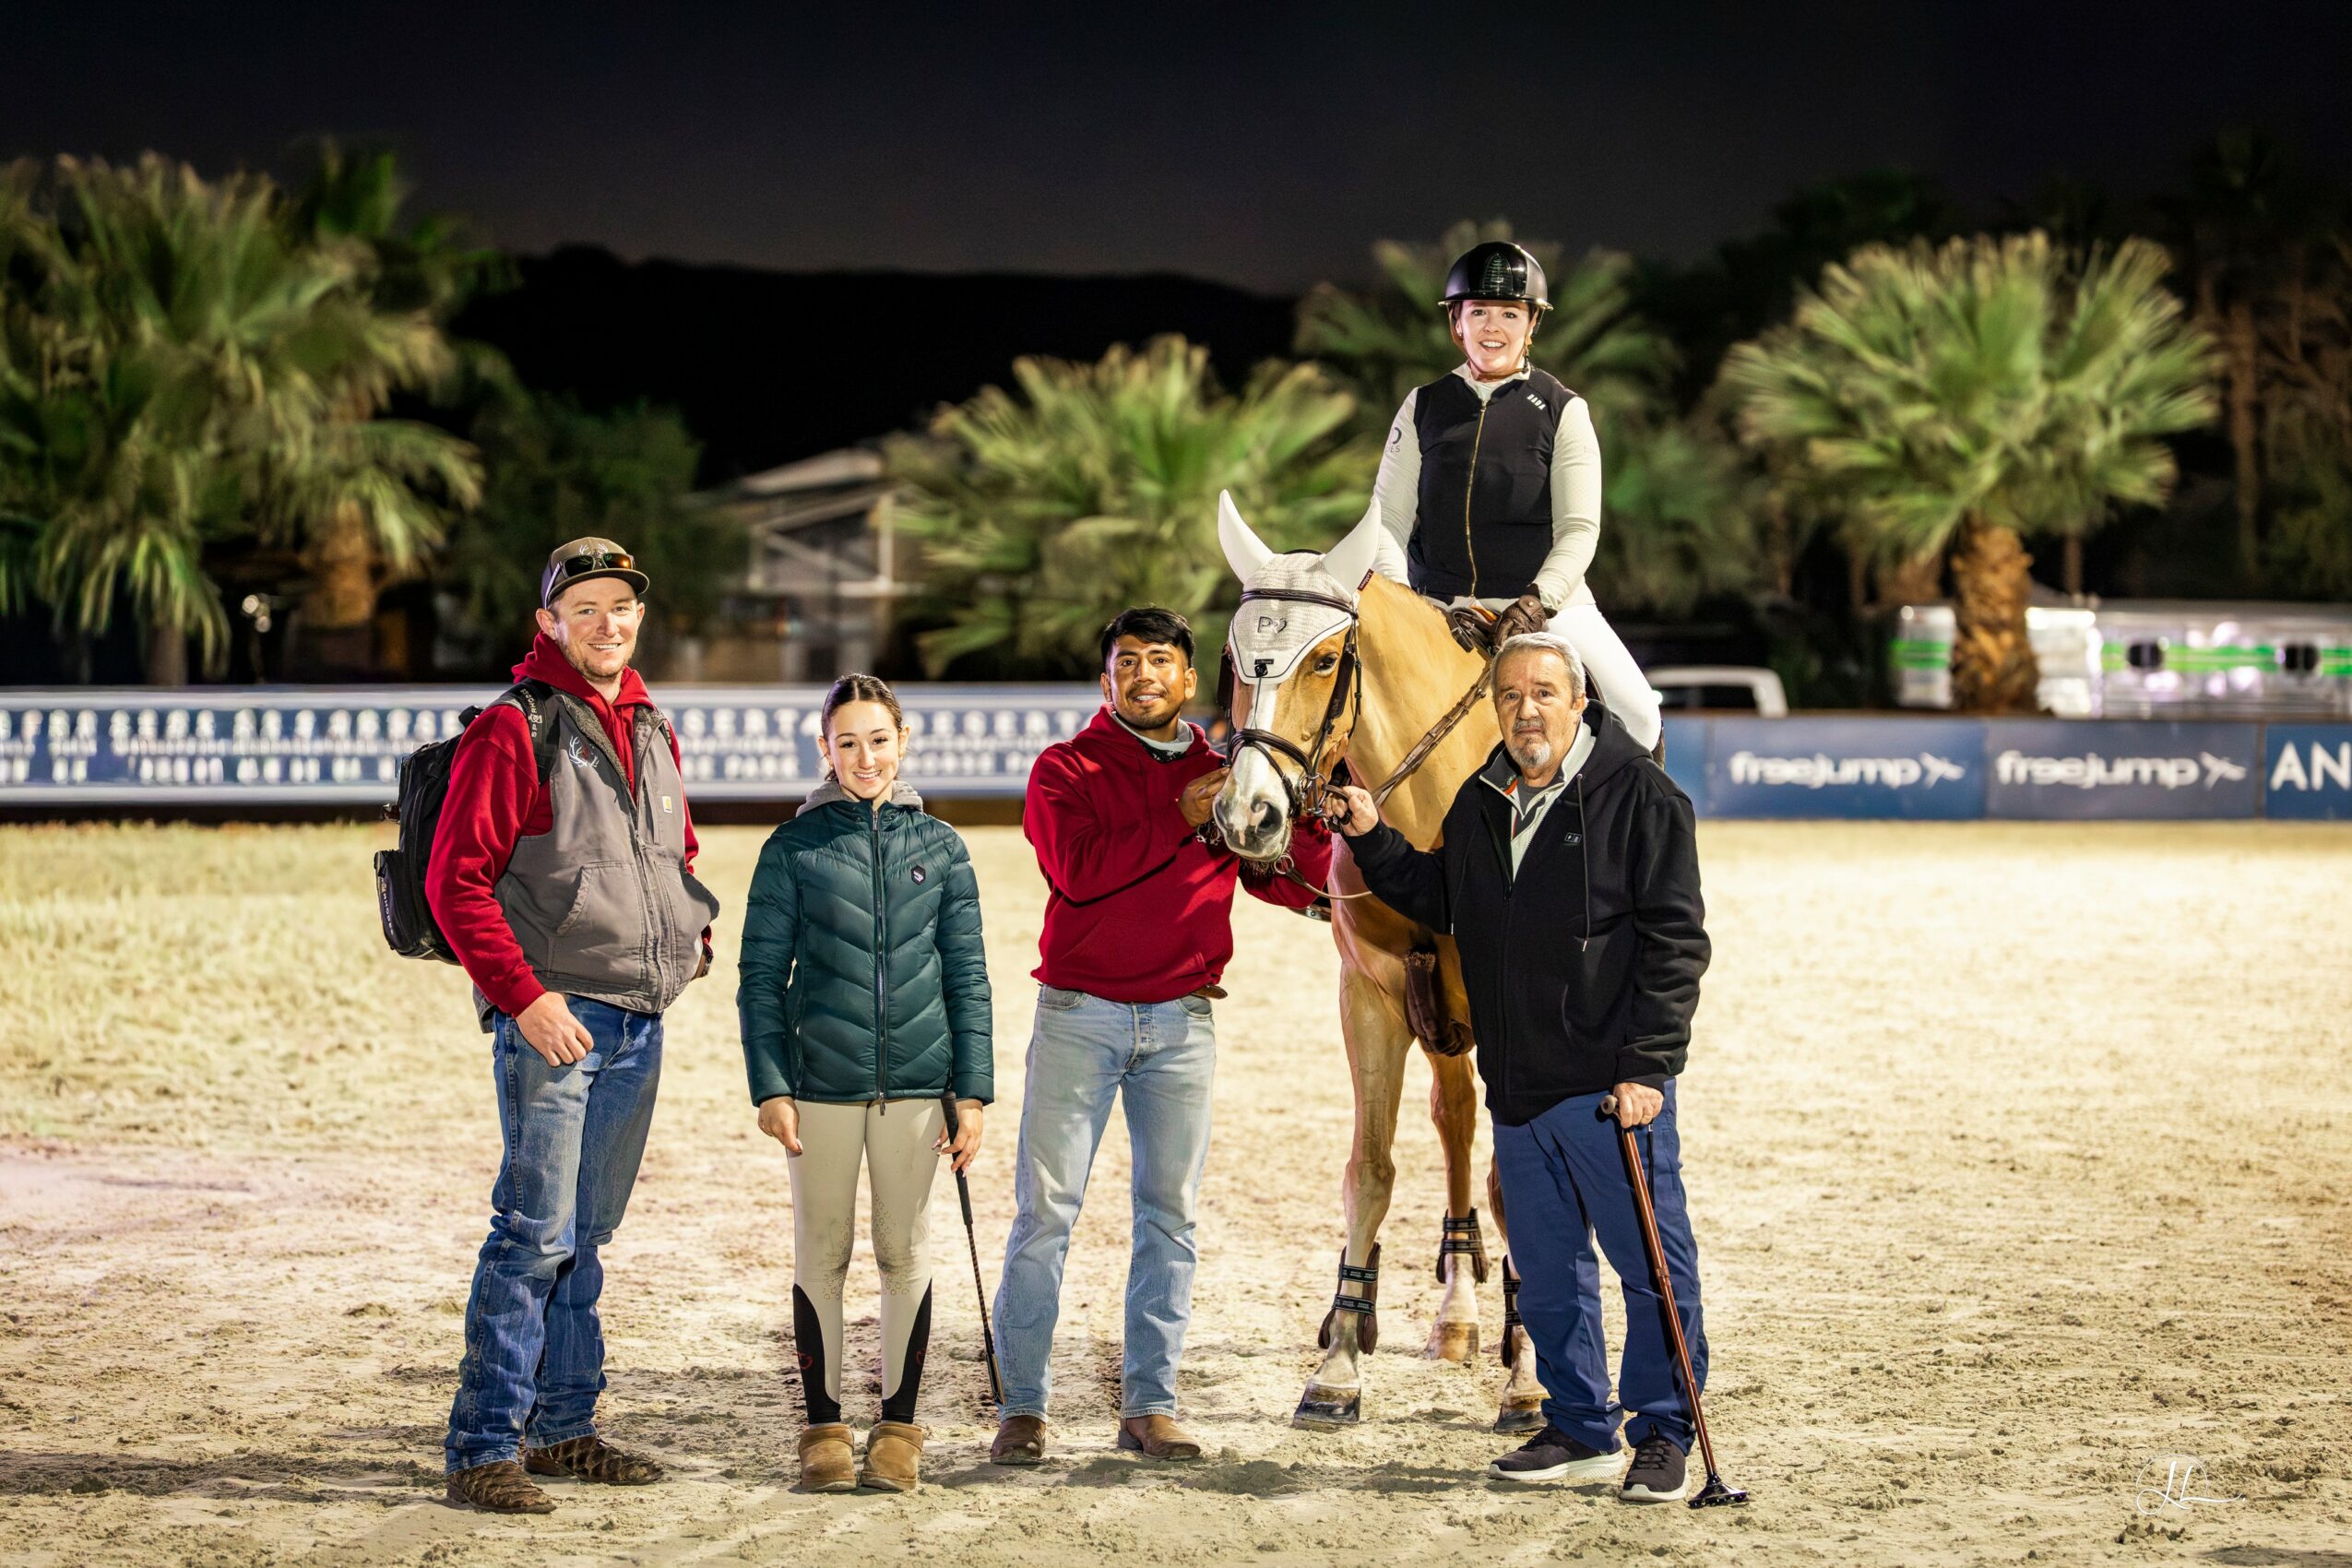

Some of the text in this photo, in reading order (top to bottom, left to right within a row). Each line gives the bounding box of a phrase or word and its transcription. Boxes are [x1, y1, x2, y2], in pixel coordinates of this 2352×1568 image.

[1728, 750, 1922, 790] freejump
[1995, 750, 2201, 790] freejump
[2269, 741, 2352, 791] AN
